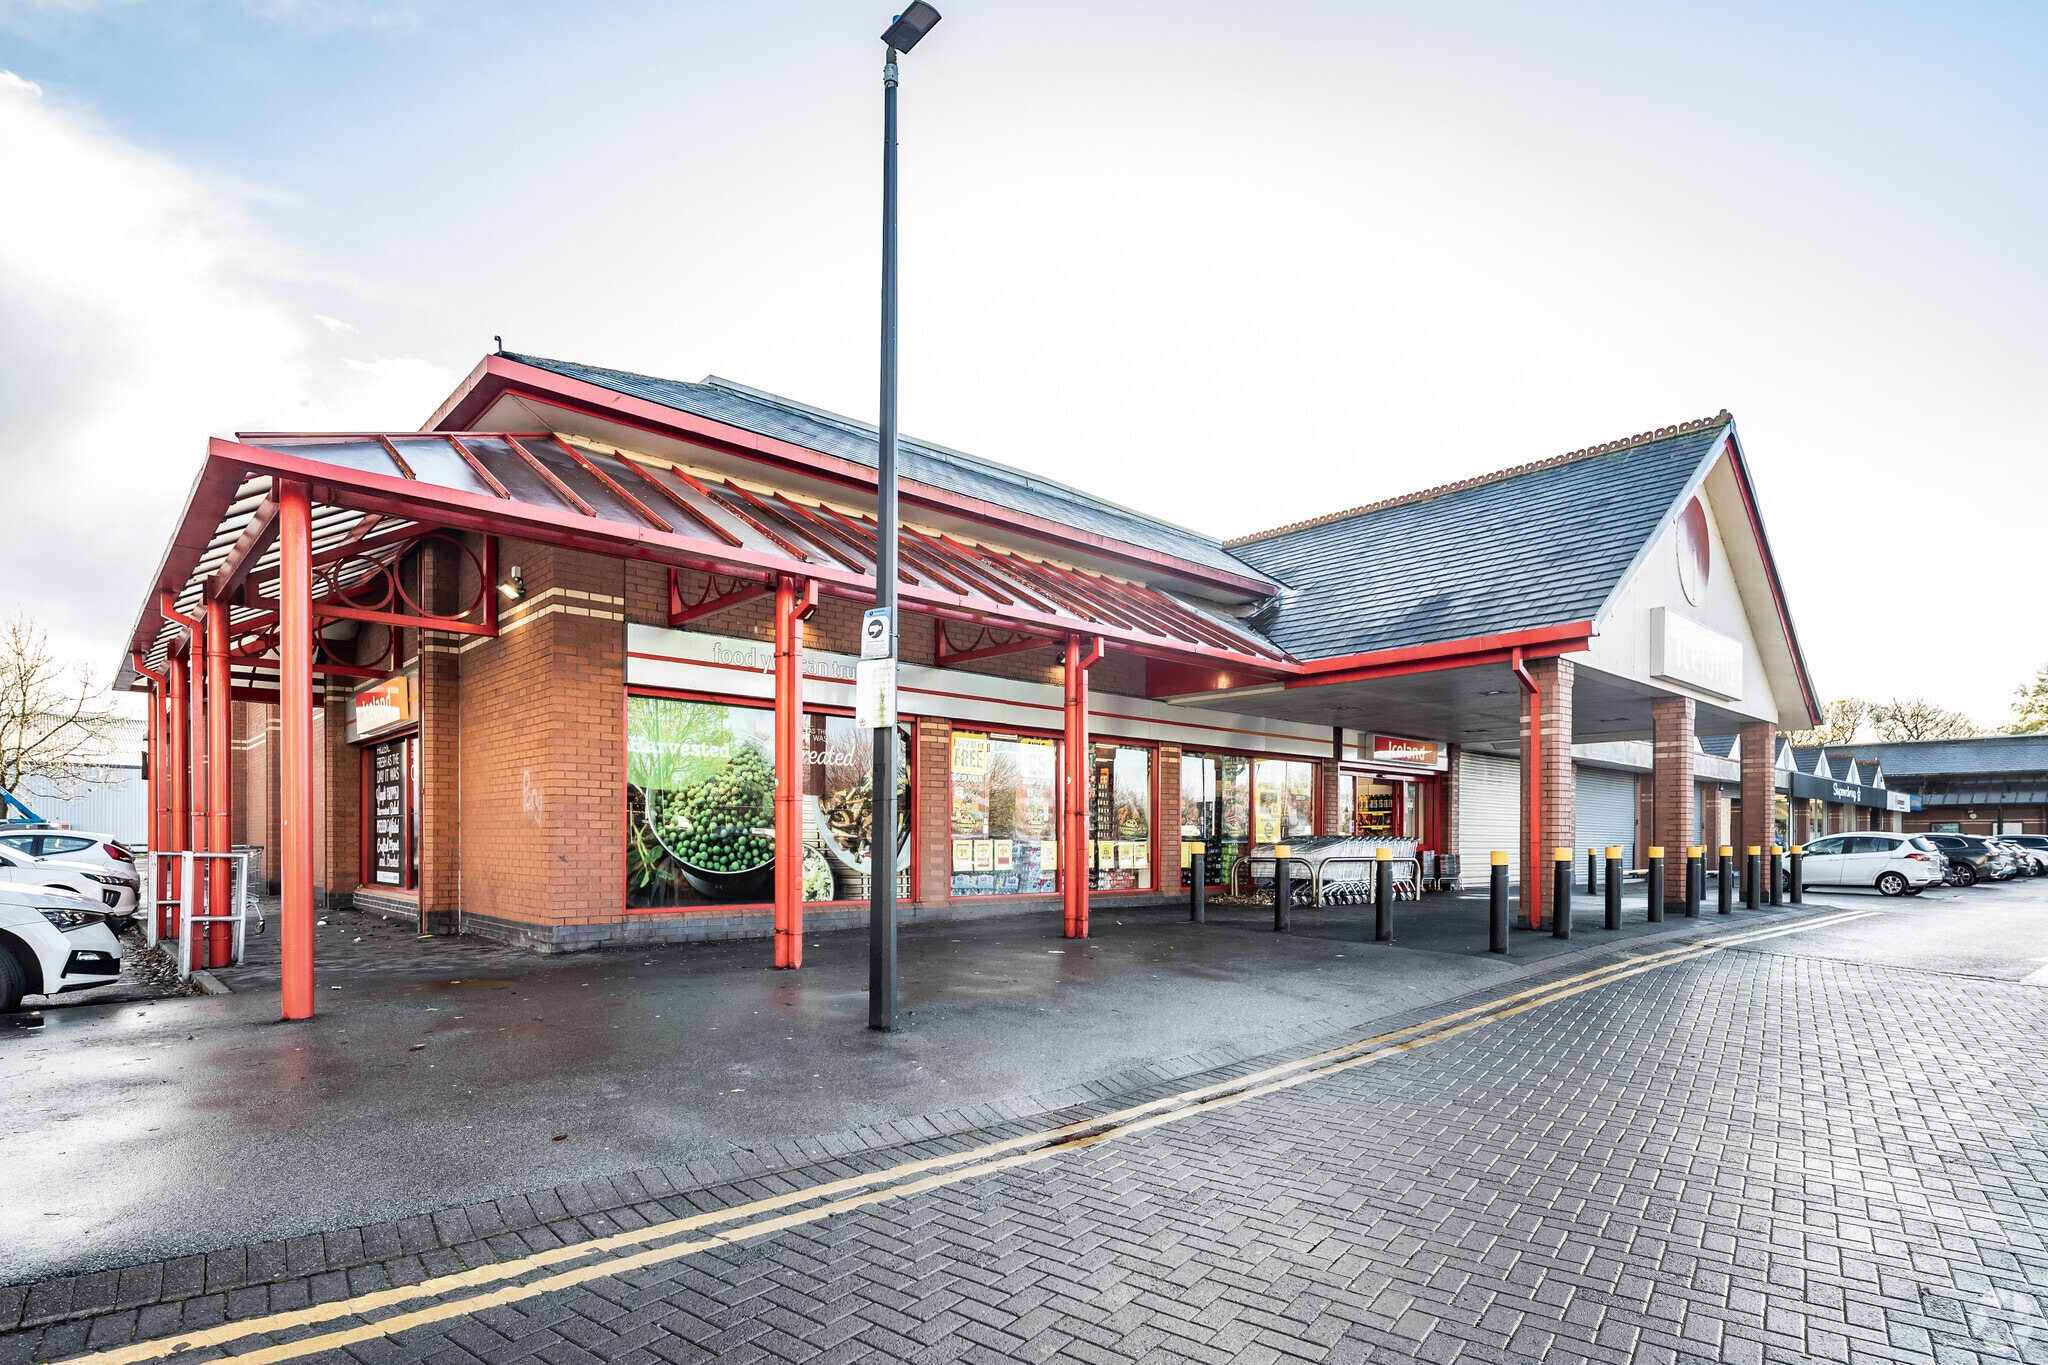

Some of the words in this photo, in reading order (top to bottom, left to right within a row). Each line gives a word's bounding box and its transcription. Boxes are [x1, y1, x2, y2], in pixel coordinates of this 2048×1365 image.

[713, 642, 756, 668] food
[833, 660, 856, 680] tru
[628, 736, 731, 759] Harvested
[803, 744, 857, 767] reated
[954, 748, 983, 769] FREE
[1388, 740, 1425, 761] Iceland
[1832, 782, 1857, 802] Superdrug
